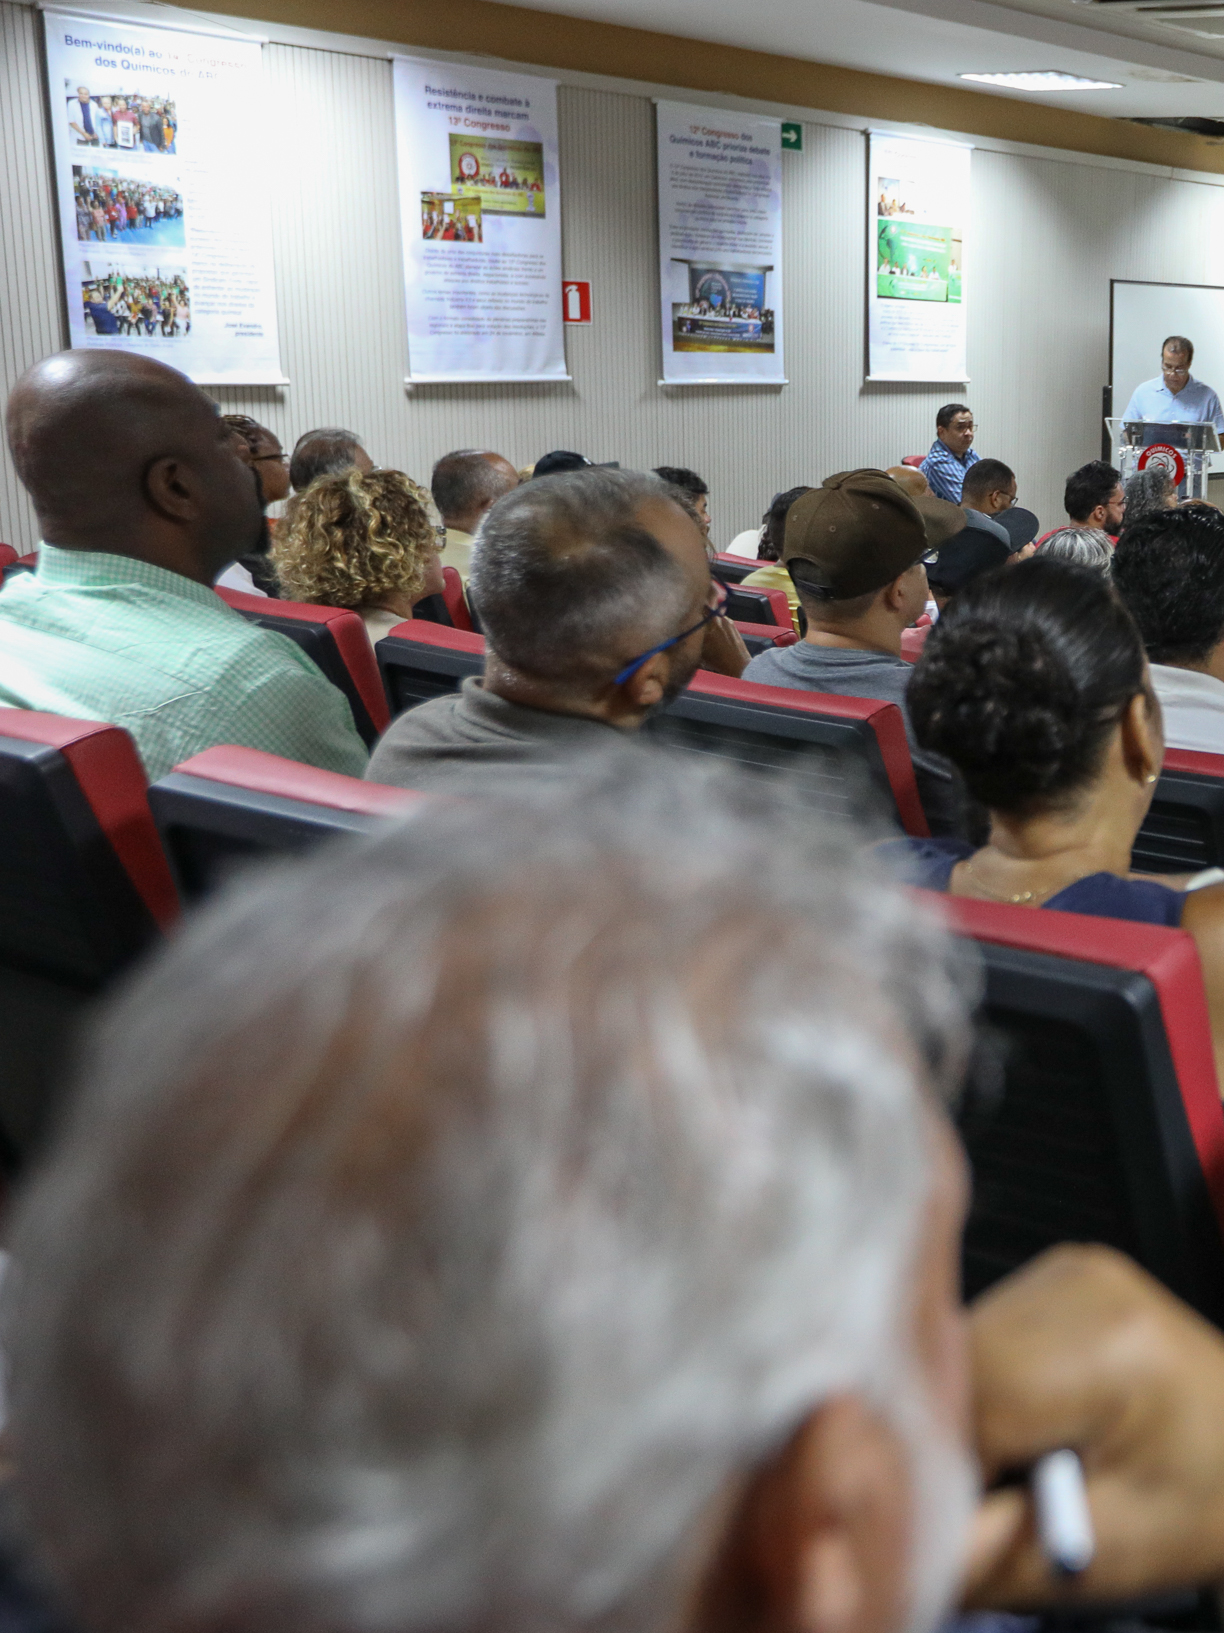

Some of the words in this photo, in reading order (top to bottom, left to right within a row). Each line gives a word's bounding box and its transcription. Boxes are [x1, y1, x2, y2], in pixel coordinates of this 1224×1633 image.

[65, 34, 145, 57] Bem-vindo(a)
[95, 56, 117, 68] dos
[464, 117, 511, 132] Congresso
